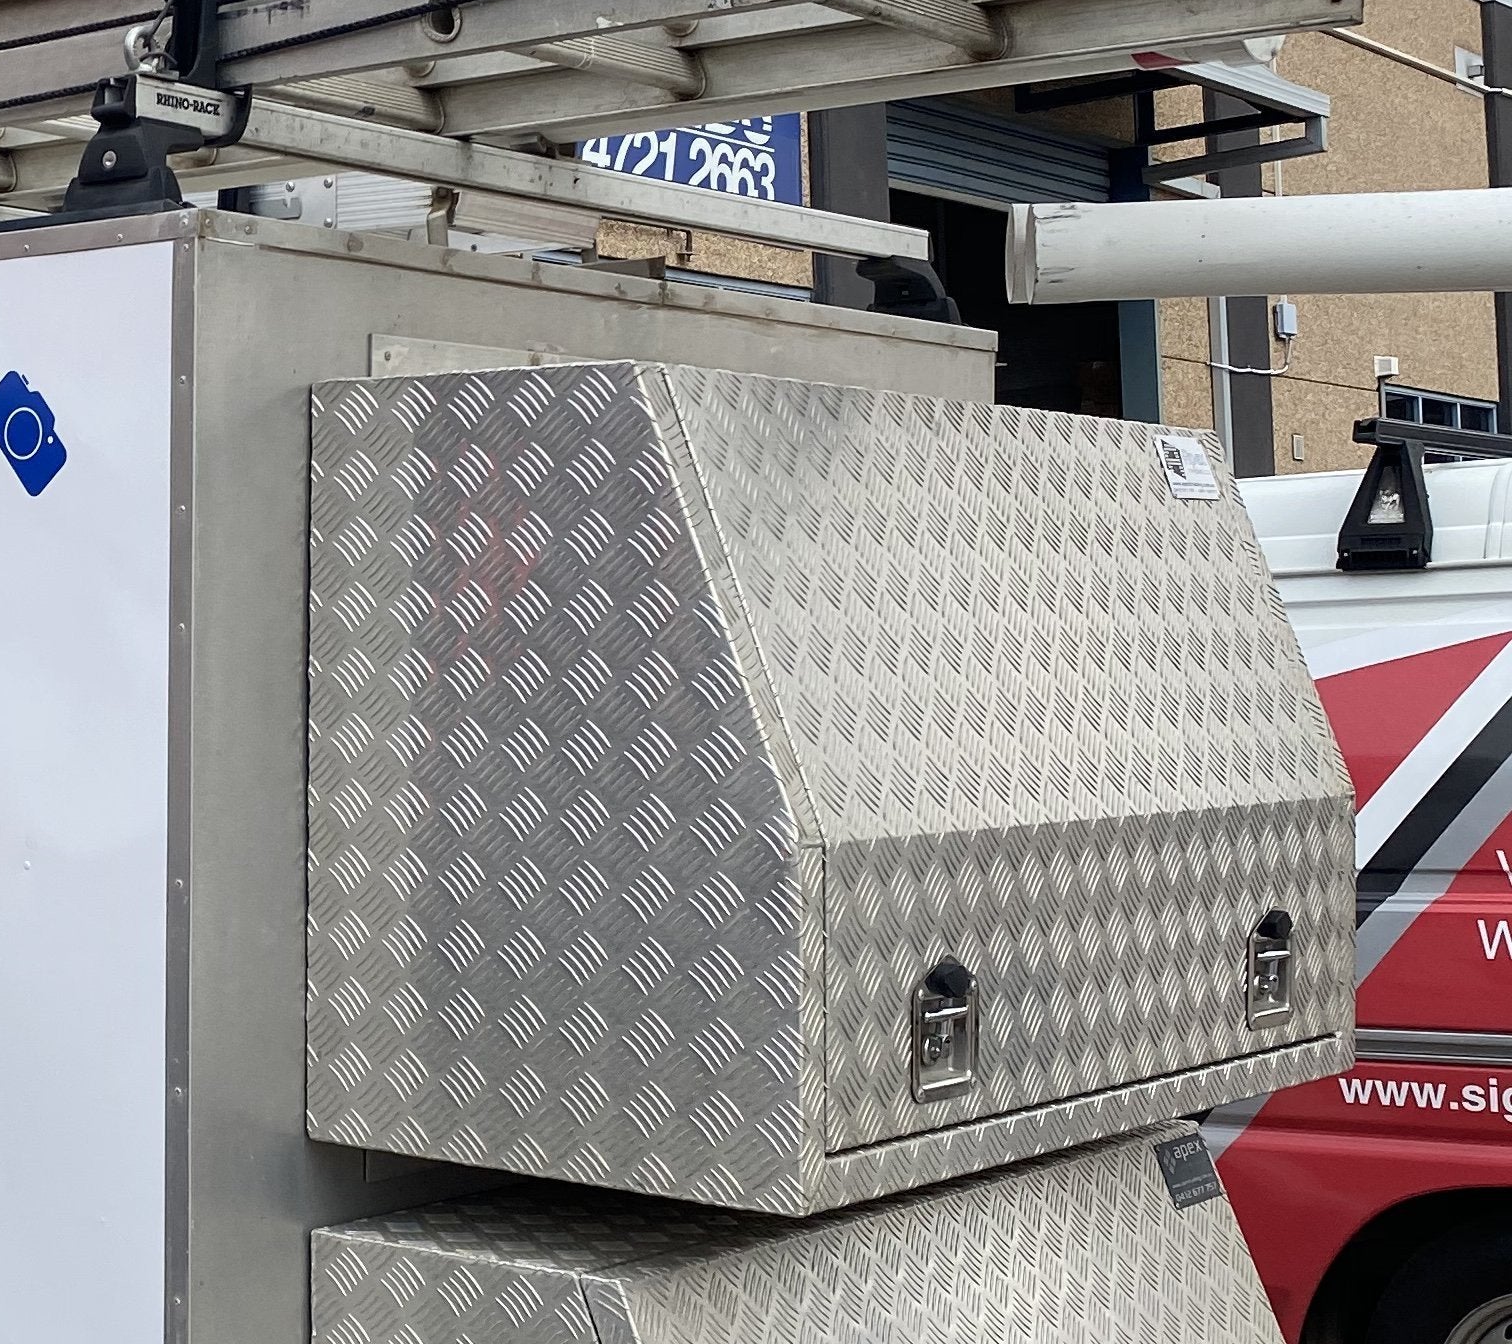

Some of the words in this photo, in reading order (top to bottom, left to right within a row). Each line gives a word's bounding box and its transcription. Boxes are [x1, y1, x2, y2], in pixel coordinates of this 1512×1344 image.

[156, 92, 221, 116] RHINO-RACK
[689, 137, 776, 201] 2663
[1172, 1140, 1203, 1162] apex
